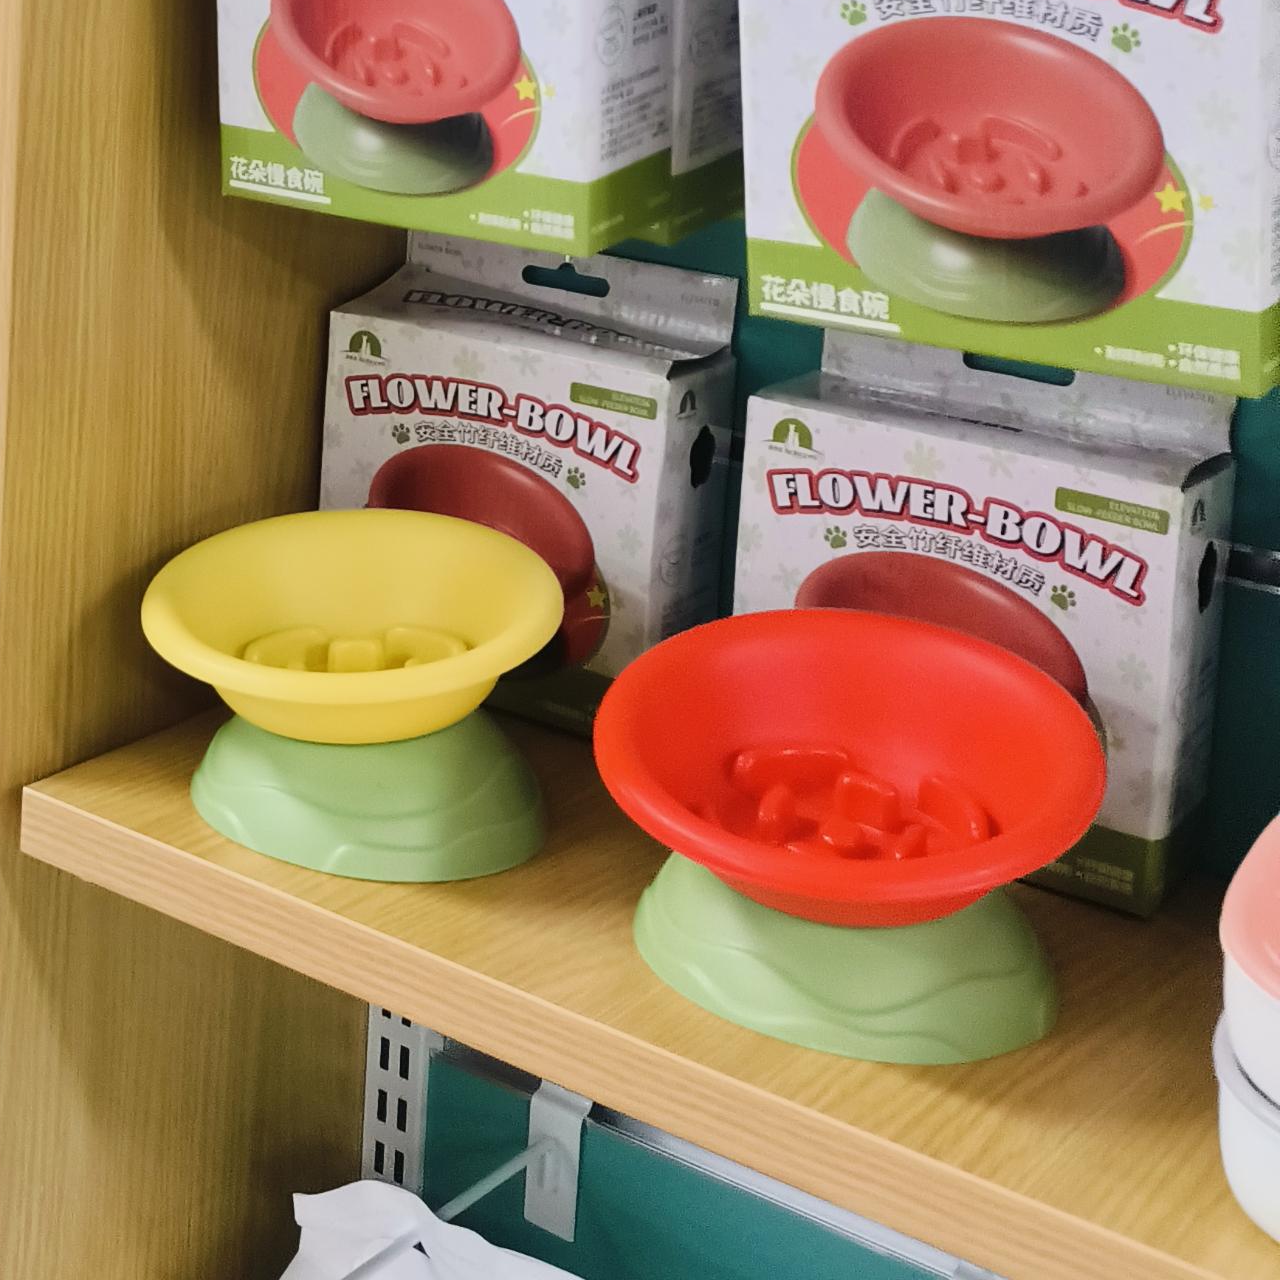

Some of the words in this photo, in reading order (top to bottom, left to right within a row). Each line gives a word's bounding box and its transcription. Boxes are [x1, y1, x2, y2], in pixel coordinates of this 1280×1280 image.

[229, 155, 325, 195] 花朵慢食碗
[760, 274, 890, 321] 花朵慢食碗
[346, 374, 640, 481] FLOWER-BOWL
[414, 420, 564, 479] 安全竹纤维材质
[768, 469, 1146, 604] FLOWER-BOWL
[853, 523, 1047, 595] 安全竹纤维材质
